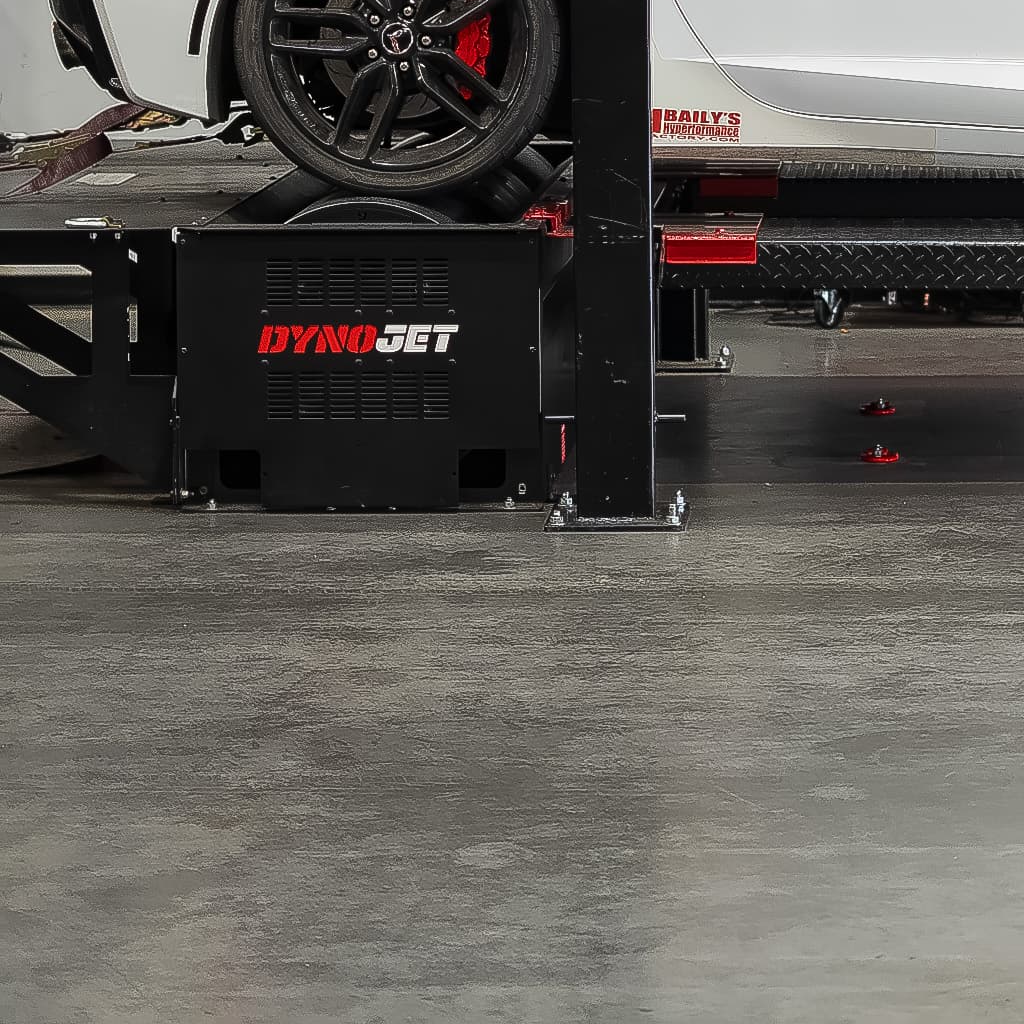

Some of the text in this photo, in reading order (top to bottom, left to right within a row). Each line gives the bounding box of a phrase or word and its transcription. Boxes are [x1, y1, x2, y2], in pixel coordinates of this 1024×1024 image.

[663, 109, 741, 126] BAILY'S
[652, 133, 740, 143] ACTORY.COM
[663, 123, 740, 138] Hyperformance
[257, 324, 459, 354] DYNOJET
